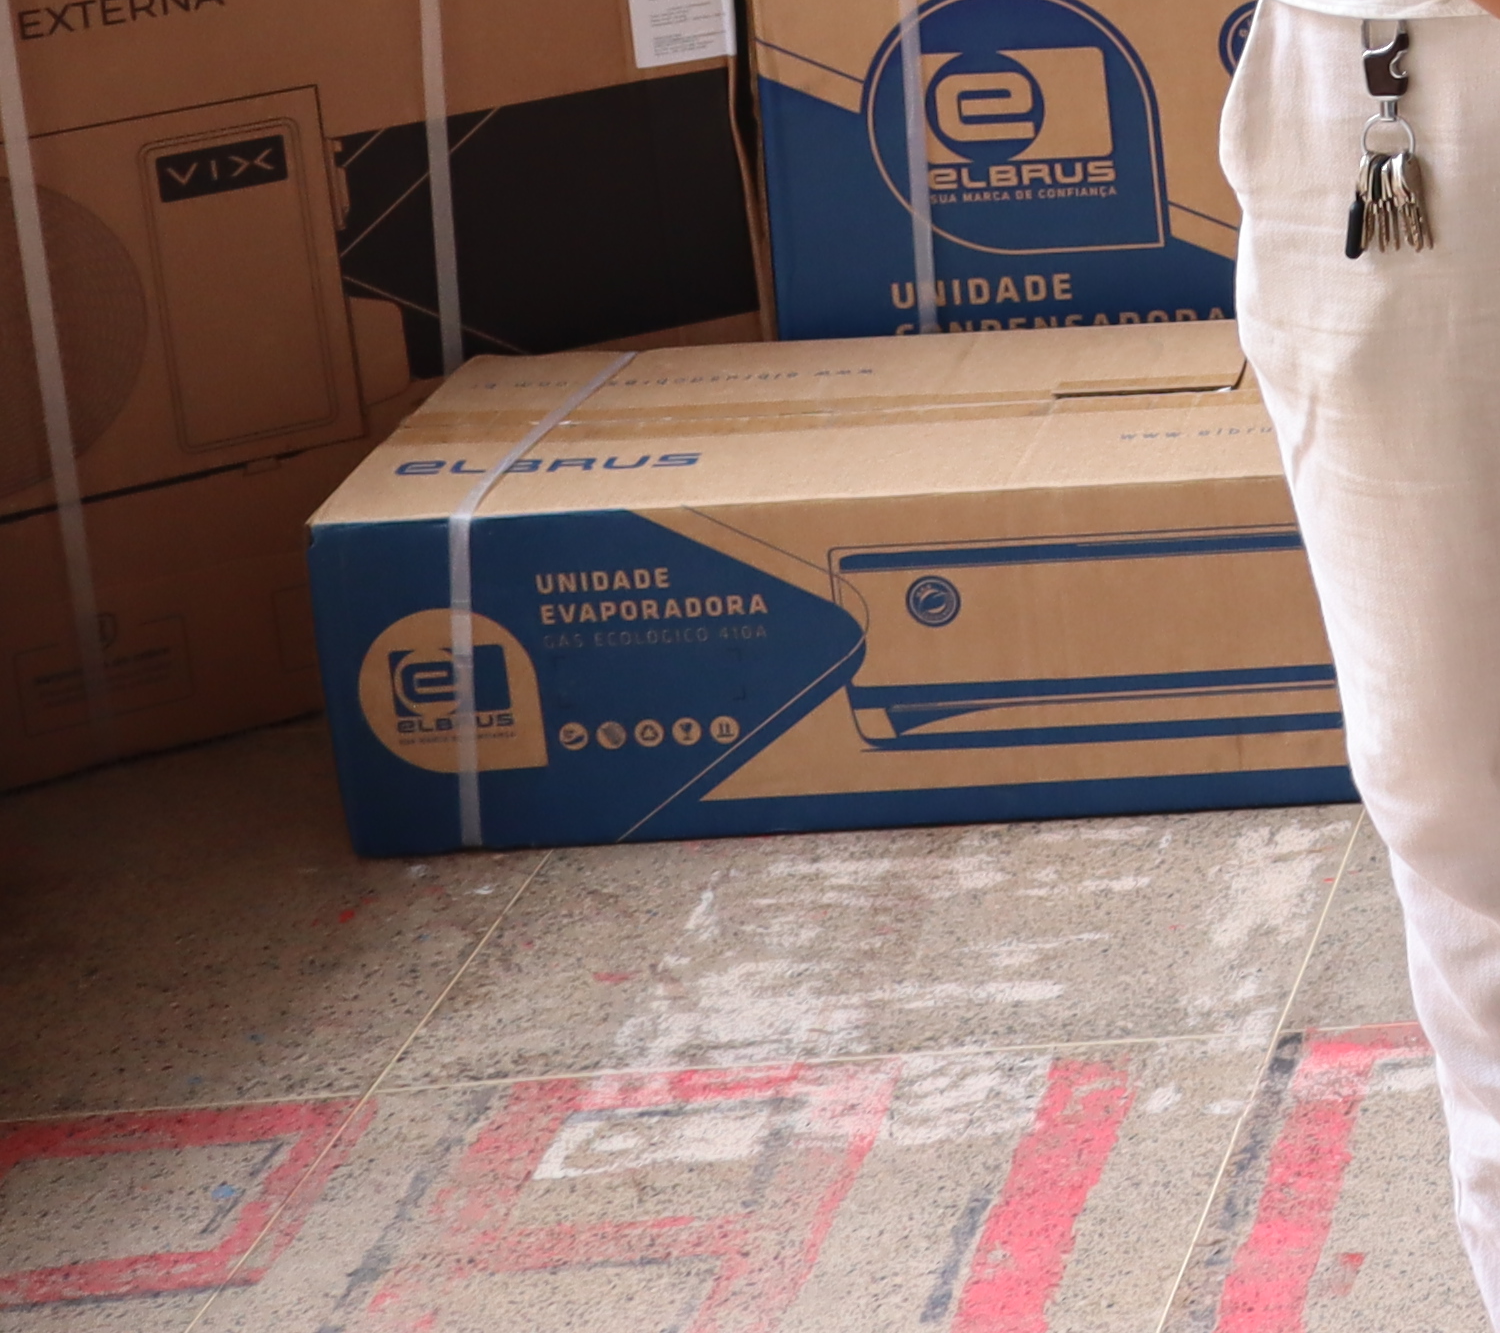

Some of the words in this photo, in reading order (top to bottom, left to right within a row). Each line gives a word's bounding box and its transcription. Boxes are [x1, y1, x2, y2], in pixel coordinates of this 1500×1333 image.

[167, 149, 274, 185] VIX
[930, 192, 956, 204] SUA
[962, 190, 1008, 202] MARCA
[1015, 189, 1032, 201] DE
[1038, 185, 1116, 200] CONFIANÇA
[536, 567, 670, 595] UNIDADE
[540, 594, 768, 626] EVAPORADORA
